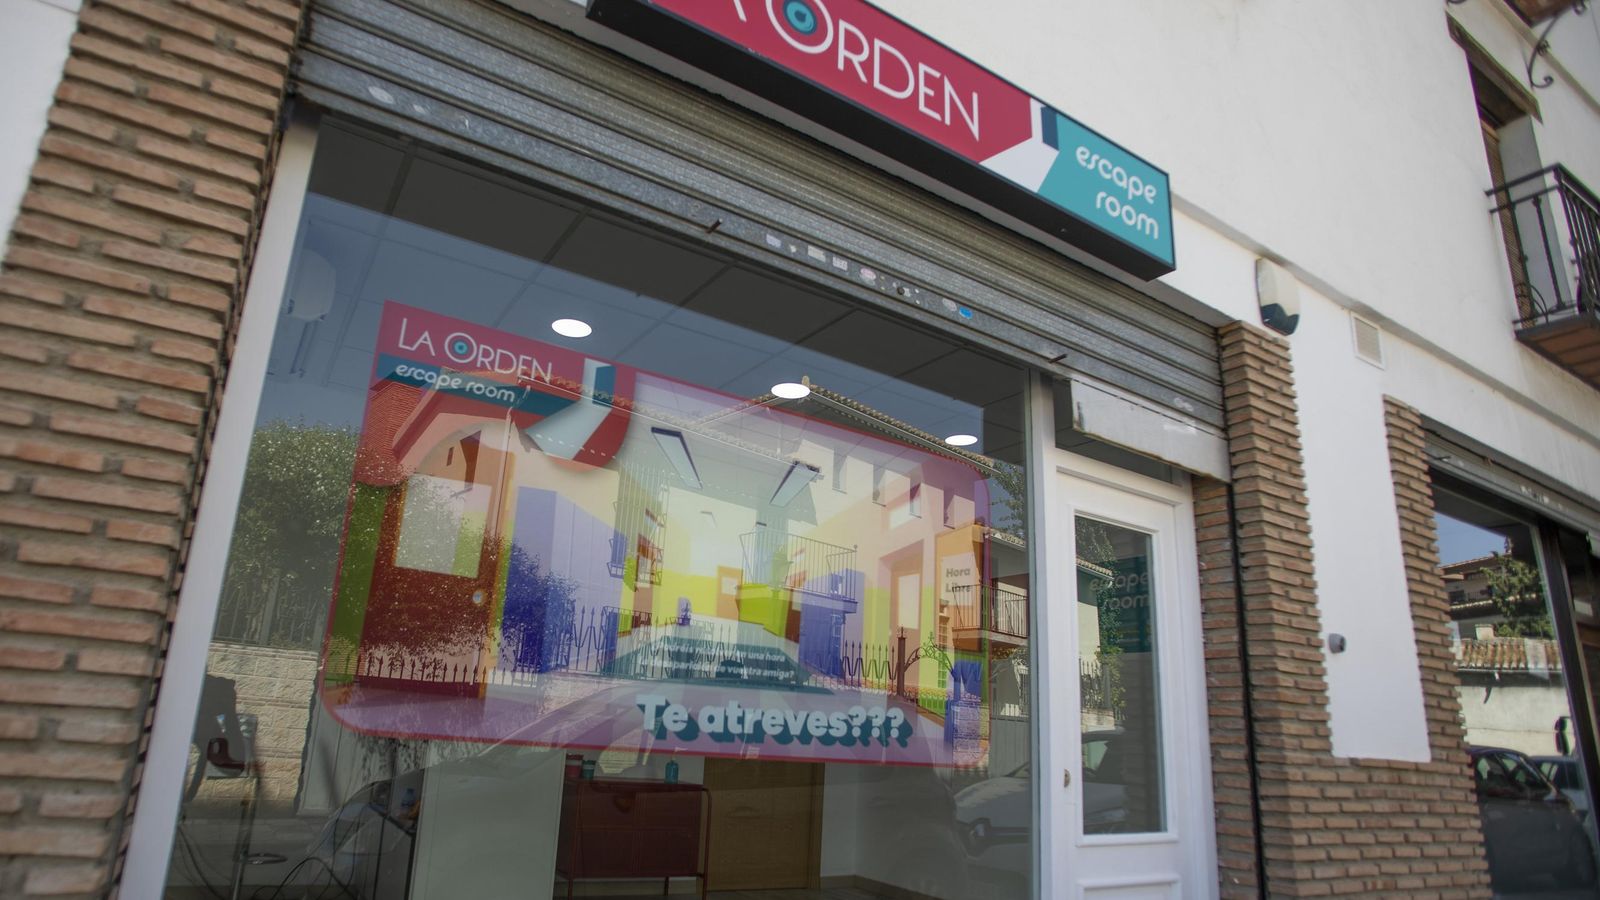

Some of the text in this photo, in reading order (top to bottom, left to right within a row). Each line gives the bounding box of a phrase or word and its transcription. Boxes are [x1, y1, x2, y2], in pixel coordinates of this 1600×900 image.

[765, 0, 980, 142] ORDEN
[1076, 146, 1156, 204] escape
[1096, 191, 1158, 240] room
[398, 318, 552, 384] LA ORDEN
[396, 364, 515, 403] escape room
[945, 568, 971, 578] Hora
[1089, 571, 1149, 593] eape
[747, 651, 764, 660] una
[765, 652, 785, 662] hora
[762, 669, 795, 680] amiga?
[635, 694, 908, 745] Te atreves???
